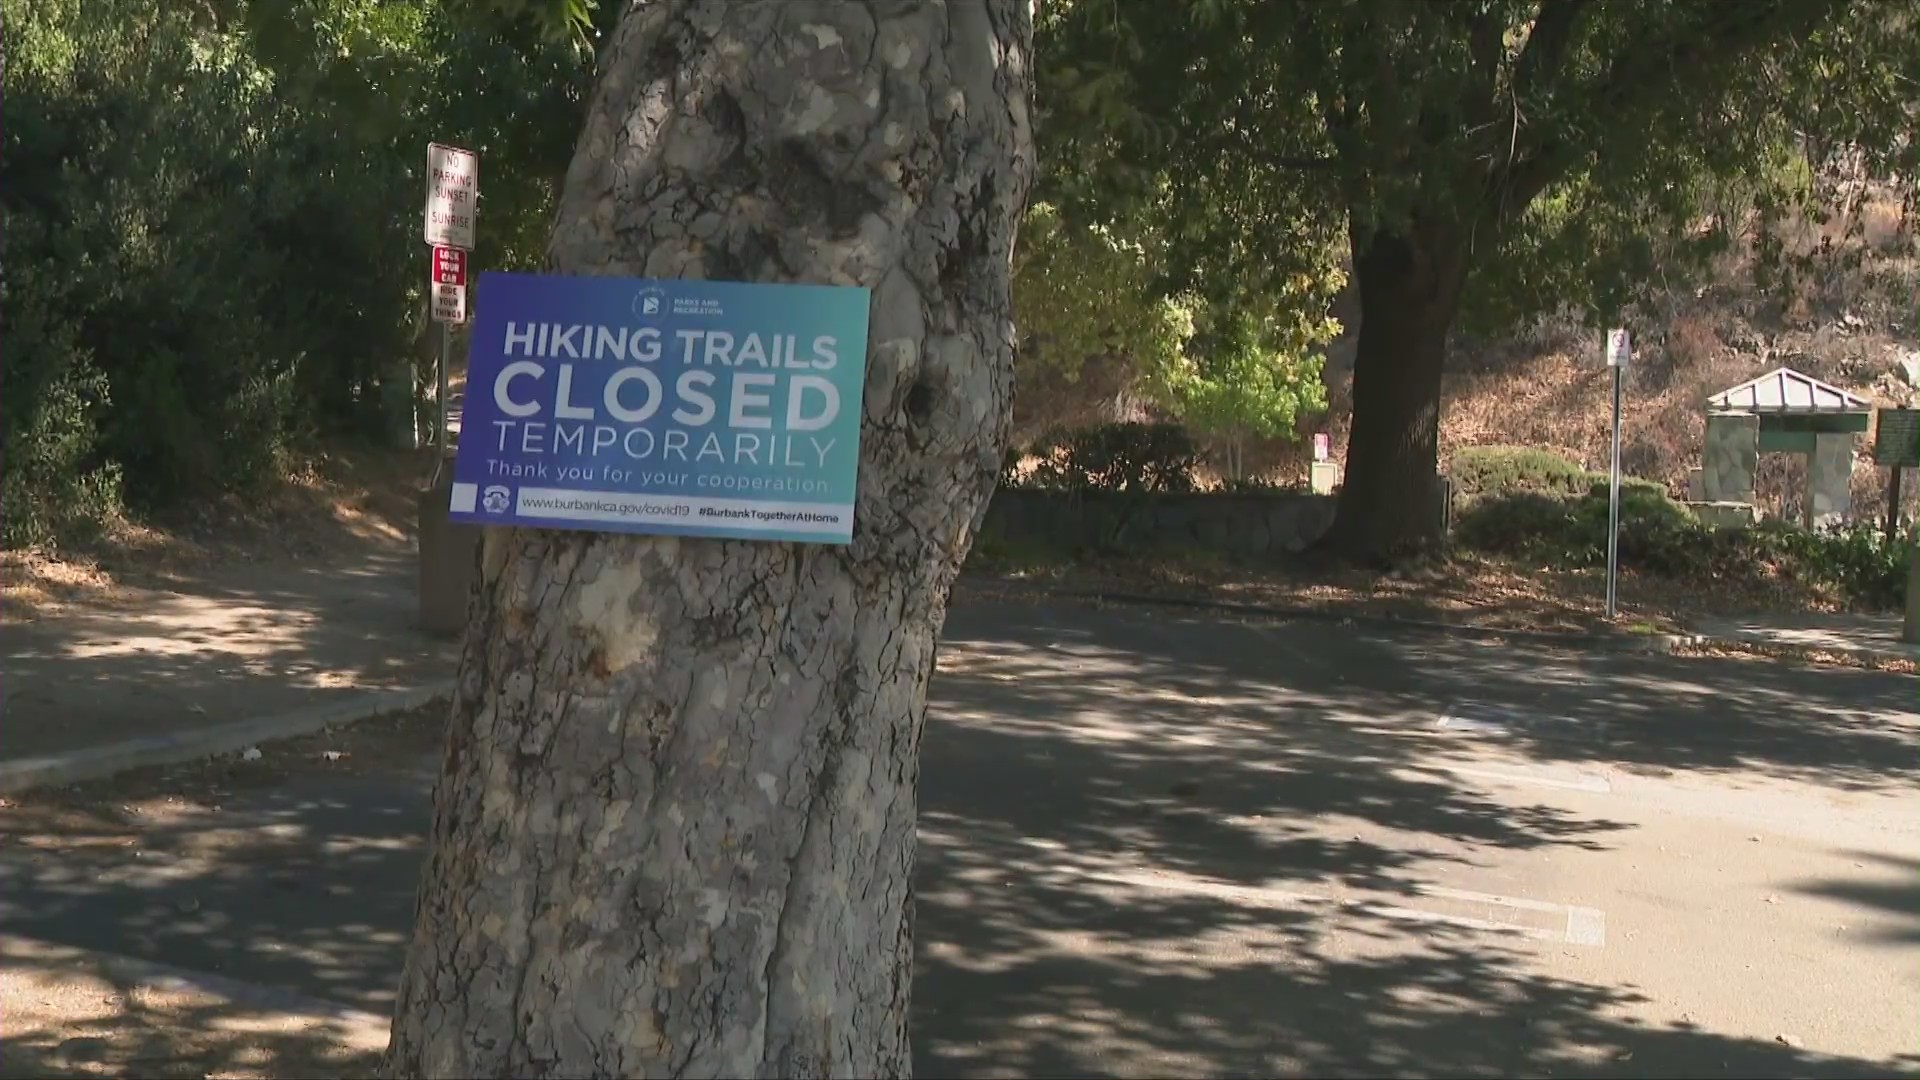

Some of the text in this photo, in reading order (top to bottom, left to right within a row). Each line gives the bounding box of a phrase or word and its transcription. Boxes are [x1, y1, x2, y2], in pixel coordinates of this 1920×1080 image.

[447, 154, 459, 168] NO
[433, 168, 472, 188] PARKING
[435, 186, 468, 204] SUNSET
[432, 212, 470, 229] SUNRISE
[440, 261, 460, 273] YOUR
[439, 297, 459, 307] YOUR
[435, 308, 462, 318] THINGS
[503, 321, 838, 370] HIKING TRAILS
[493, 360, 841, 431] CLOSED
[492, 420, 837, 469] TEMPORARILY
[487, 459, 548, 479] Thank
[556, 465, 594, 482] you
[603, 465, 633, 484] for
[642, 472, 689, 488] your
[522, 497, 840, 524] www.burbankca.gov/covid19 #BurbankTogetherAtHome
